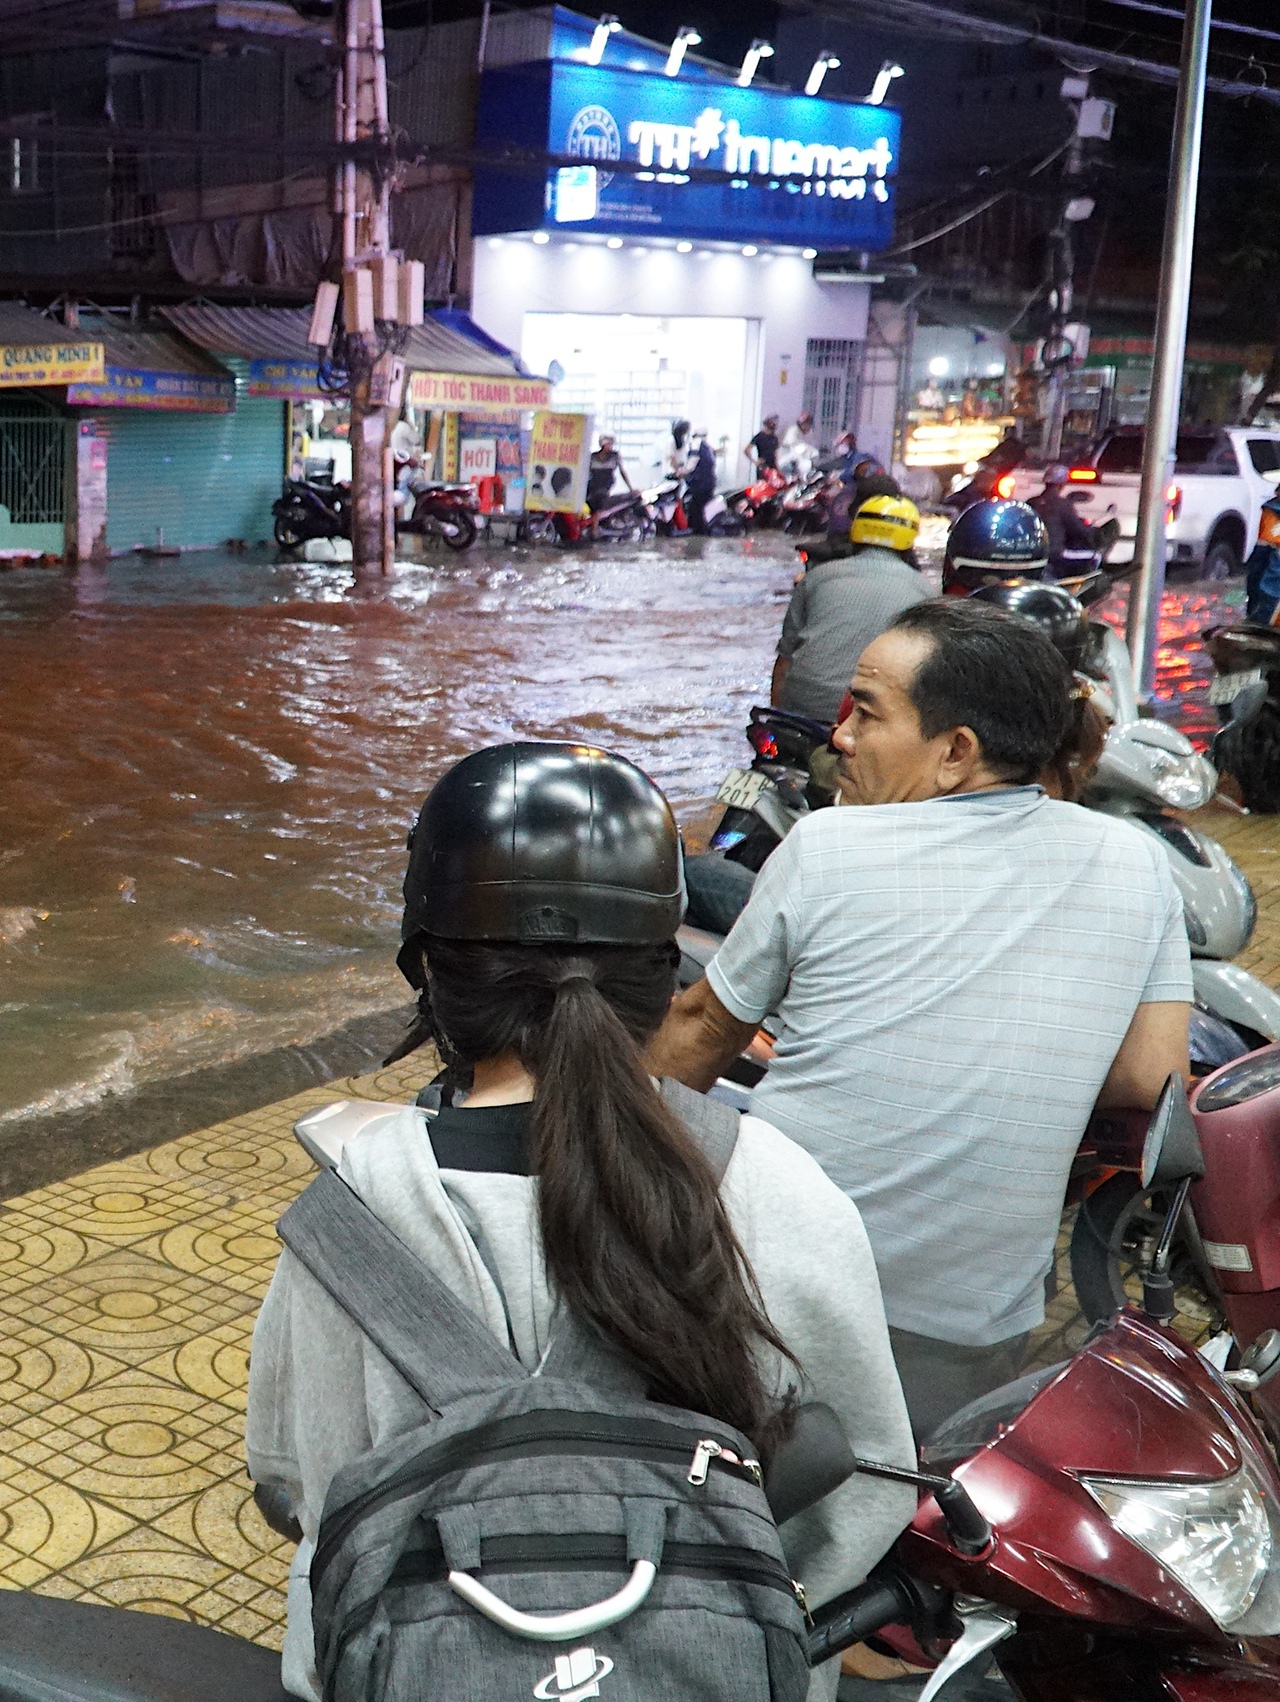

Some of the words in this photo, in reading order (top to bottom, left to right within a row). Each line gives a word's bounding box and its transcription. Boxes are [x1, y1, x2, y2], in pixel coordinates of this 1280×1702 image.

[3, 348, 52, 367] QUANG
[56, 346, 90, 362] MINH
[443, 376, 466, 400] TÓC
[470, 382, 510, 404] THANH
[514, 385, 547, 405] SANG
[464, 447, 493, 468] HỚT
